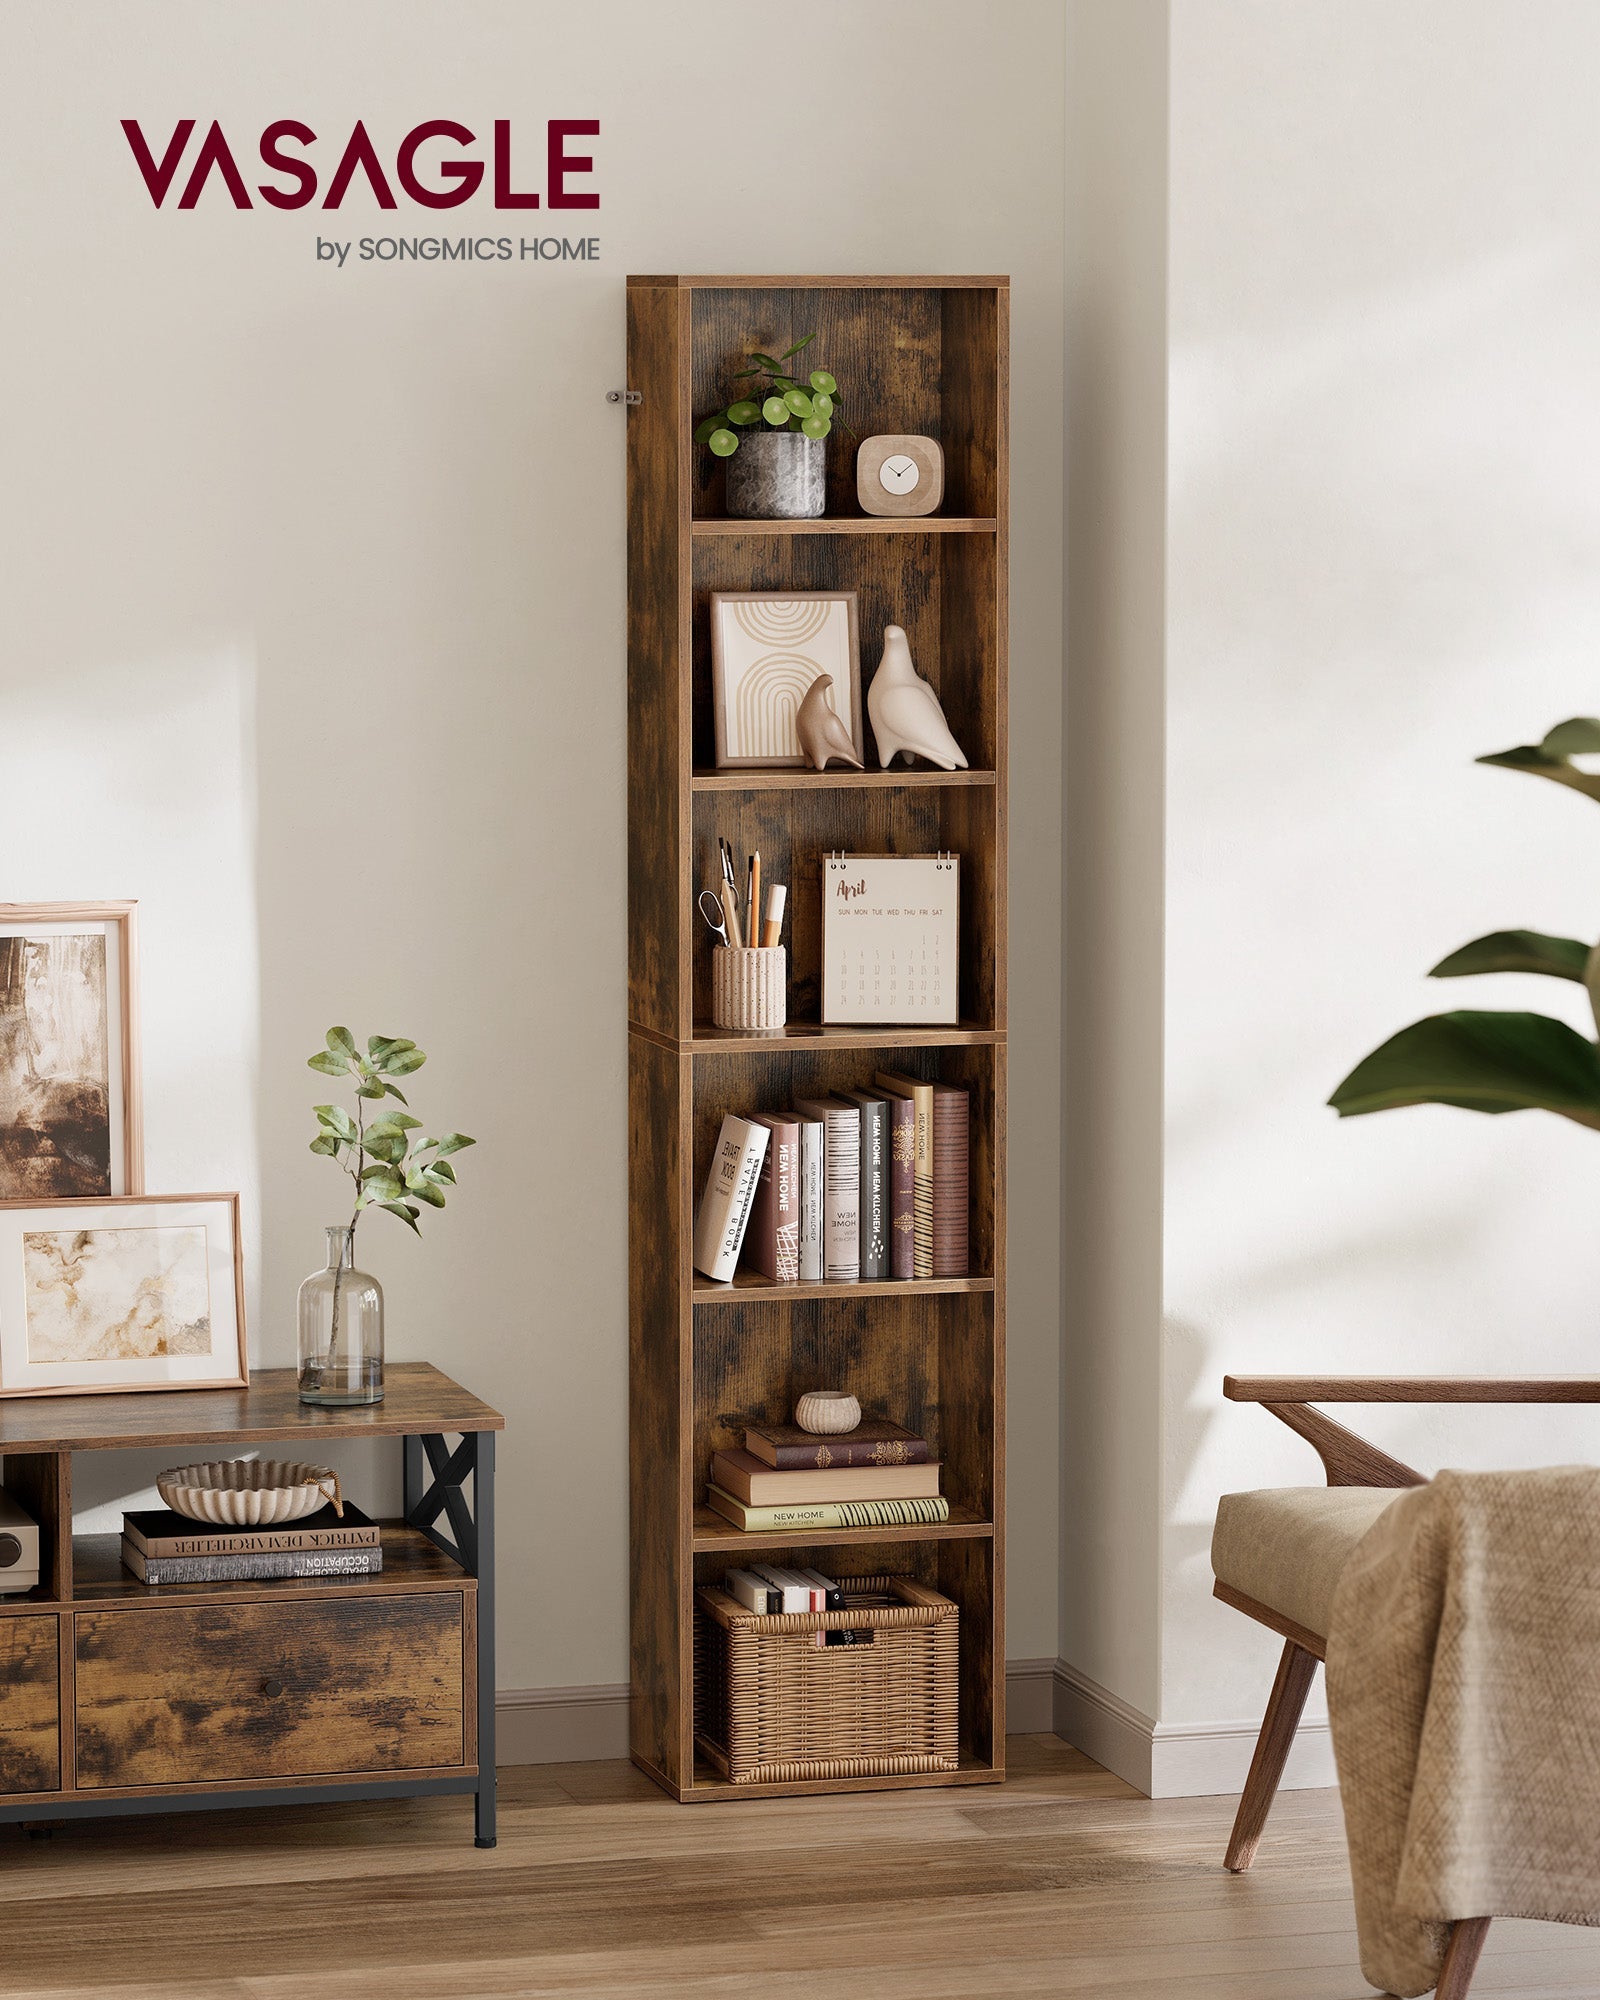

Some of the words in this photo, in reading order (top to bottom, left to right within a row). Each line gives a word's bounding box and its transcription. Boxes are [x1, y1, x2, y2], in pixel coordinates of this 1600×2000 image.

[836, 879, 867, 901] April
[838, 908, 851, 916] SUN
[854, 908, 868, 916] MON
[872, 908, 883, 916] TUE
[887, 908, 899, 916] WED
[904, 908, 916, 916] THU
[919, 908, 928, 916] FRI
[932, 908, 943, 916] SAT
[773, 1512, 795, 1521] NEW
[797, 1511, 824, 1519] HOME
[174, 1533, 303, 1553] DEMARCHELIER
[309, 1529, 377, 1547] PATRICK
[306, 1555, 370, 1568] OCCUPATION
